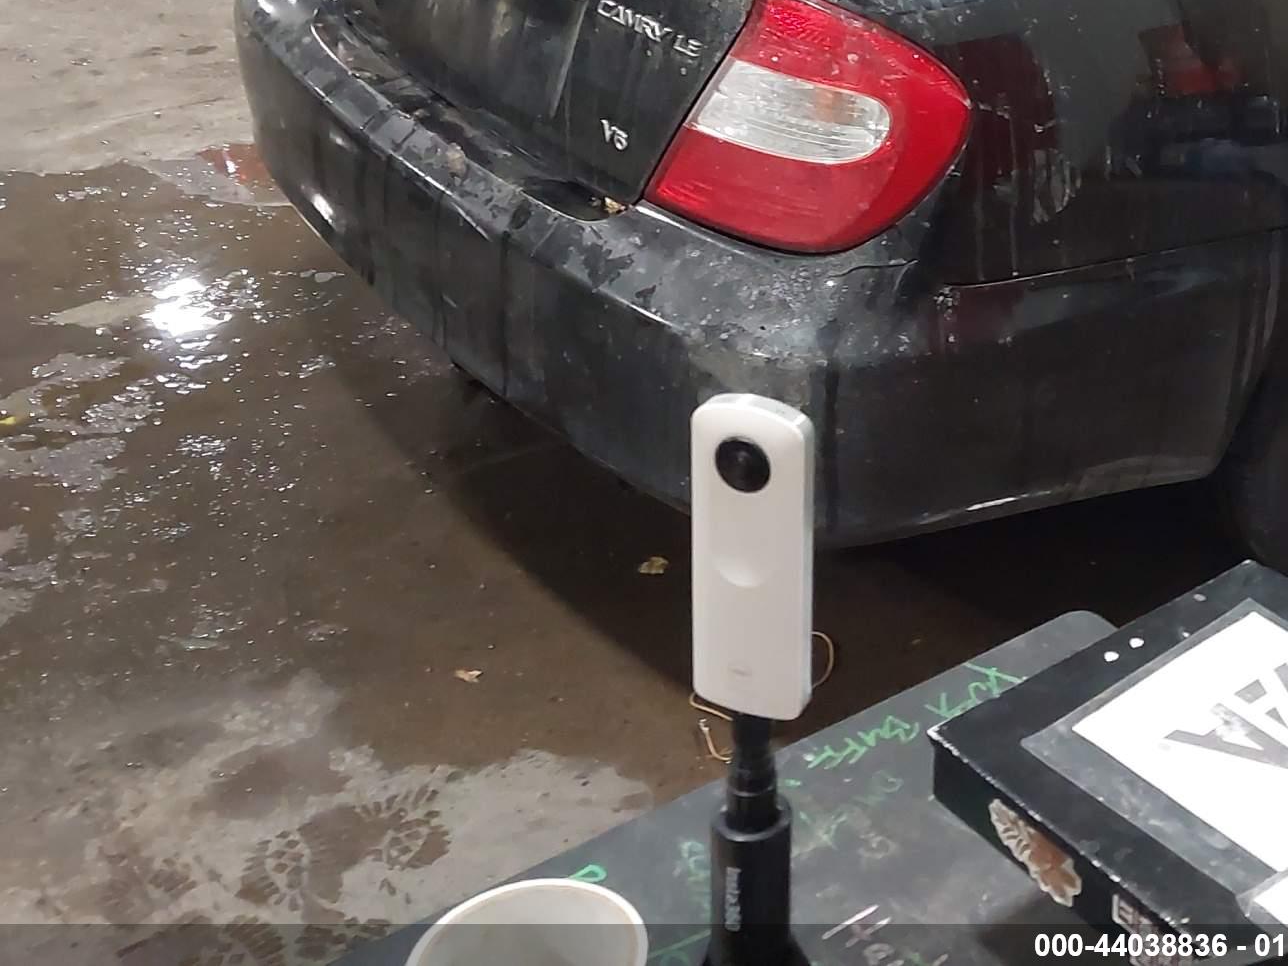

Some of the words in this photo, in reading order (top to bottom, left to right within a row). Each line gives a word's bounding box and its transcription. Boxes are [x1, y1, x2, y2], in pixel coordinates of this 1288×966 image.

[597, 0, 673, 43] CAMRY
[672, 34, 704, 58] LE
[600, 119, 629, 151] V6
